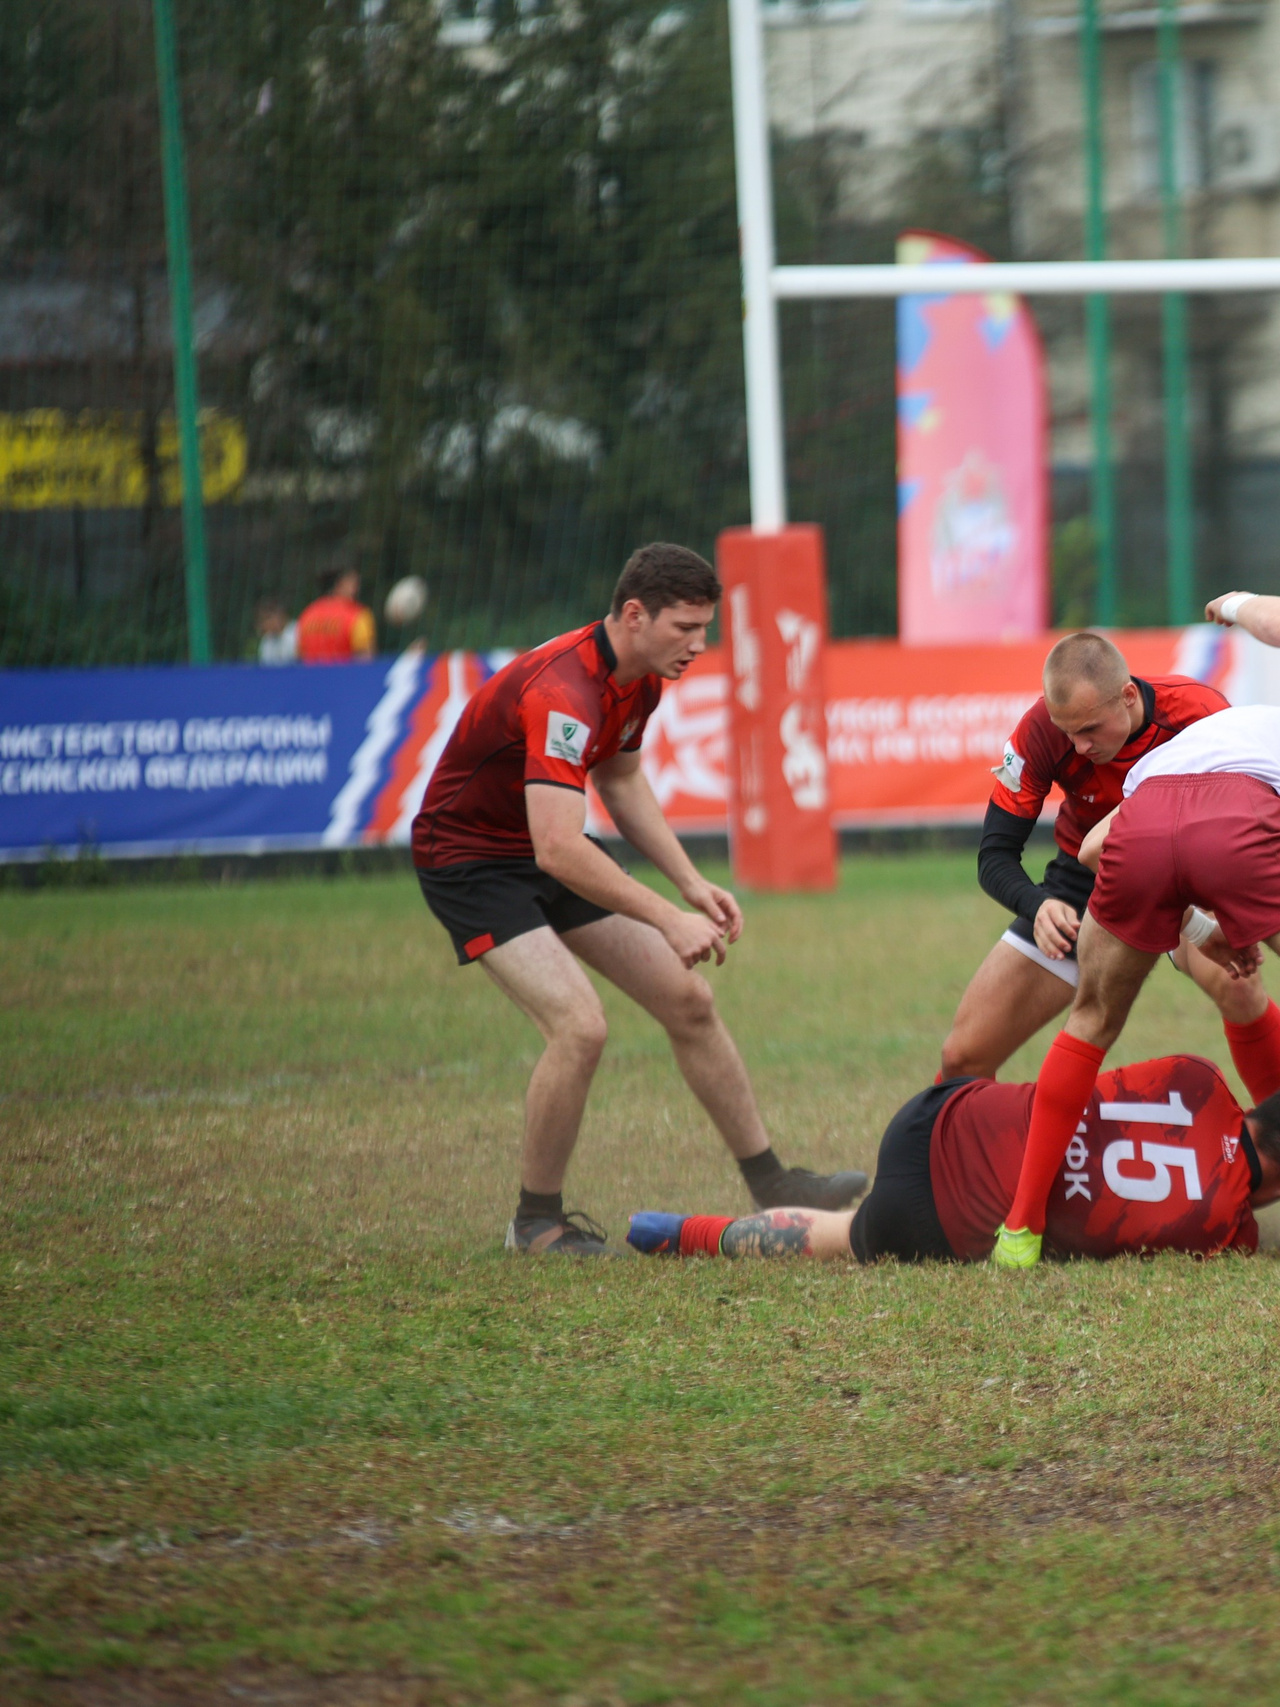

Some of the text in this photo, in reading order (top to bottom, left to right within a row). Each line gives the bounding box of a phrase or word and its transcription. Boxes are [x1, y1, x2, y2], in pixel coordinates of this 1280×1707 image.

[183, 716, 331, 752] ОБОРОНЫ
[0, 752, 328, 795] СИЙСКОЙ ФЕДЕРАЦИИ
[1099, 1090, 1203, 1203] 15
